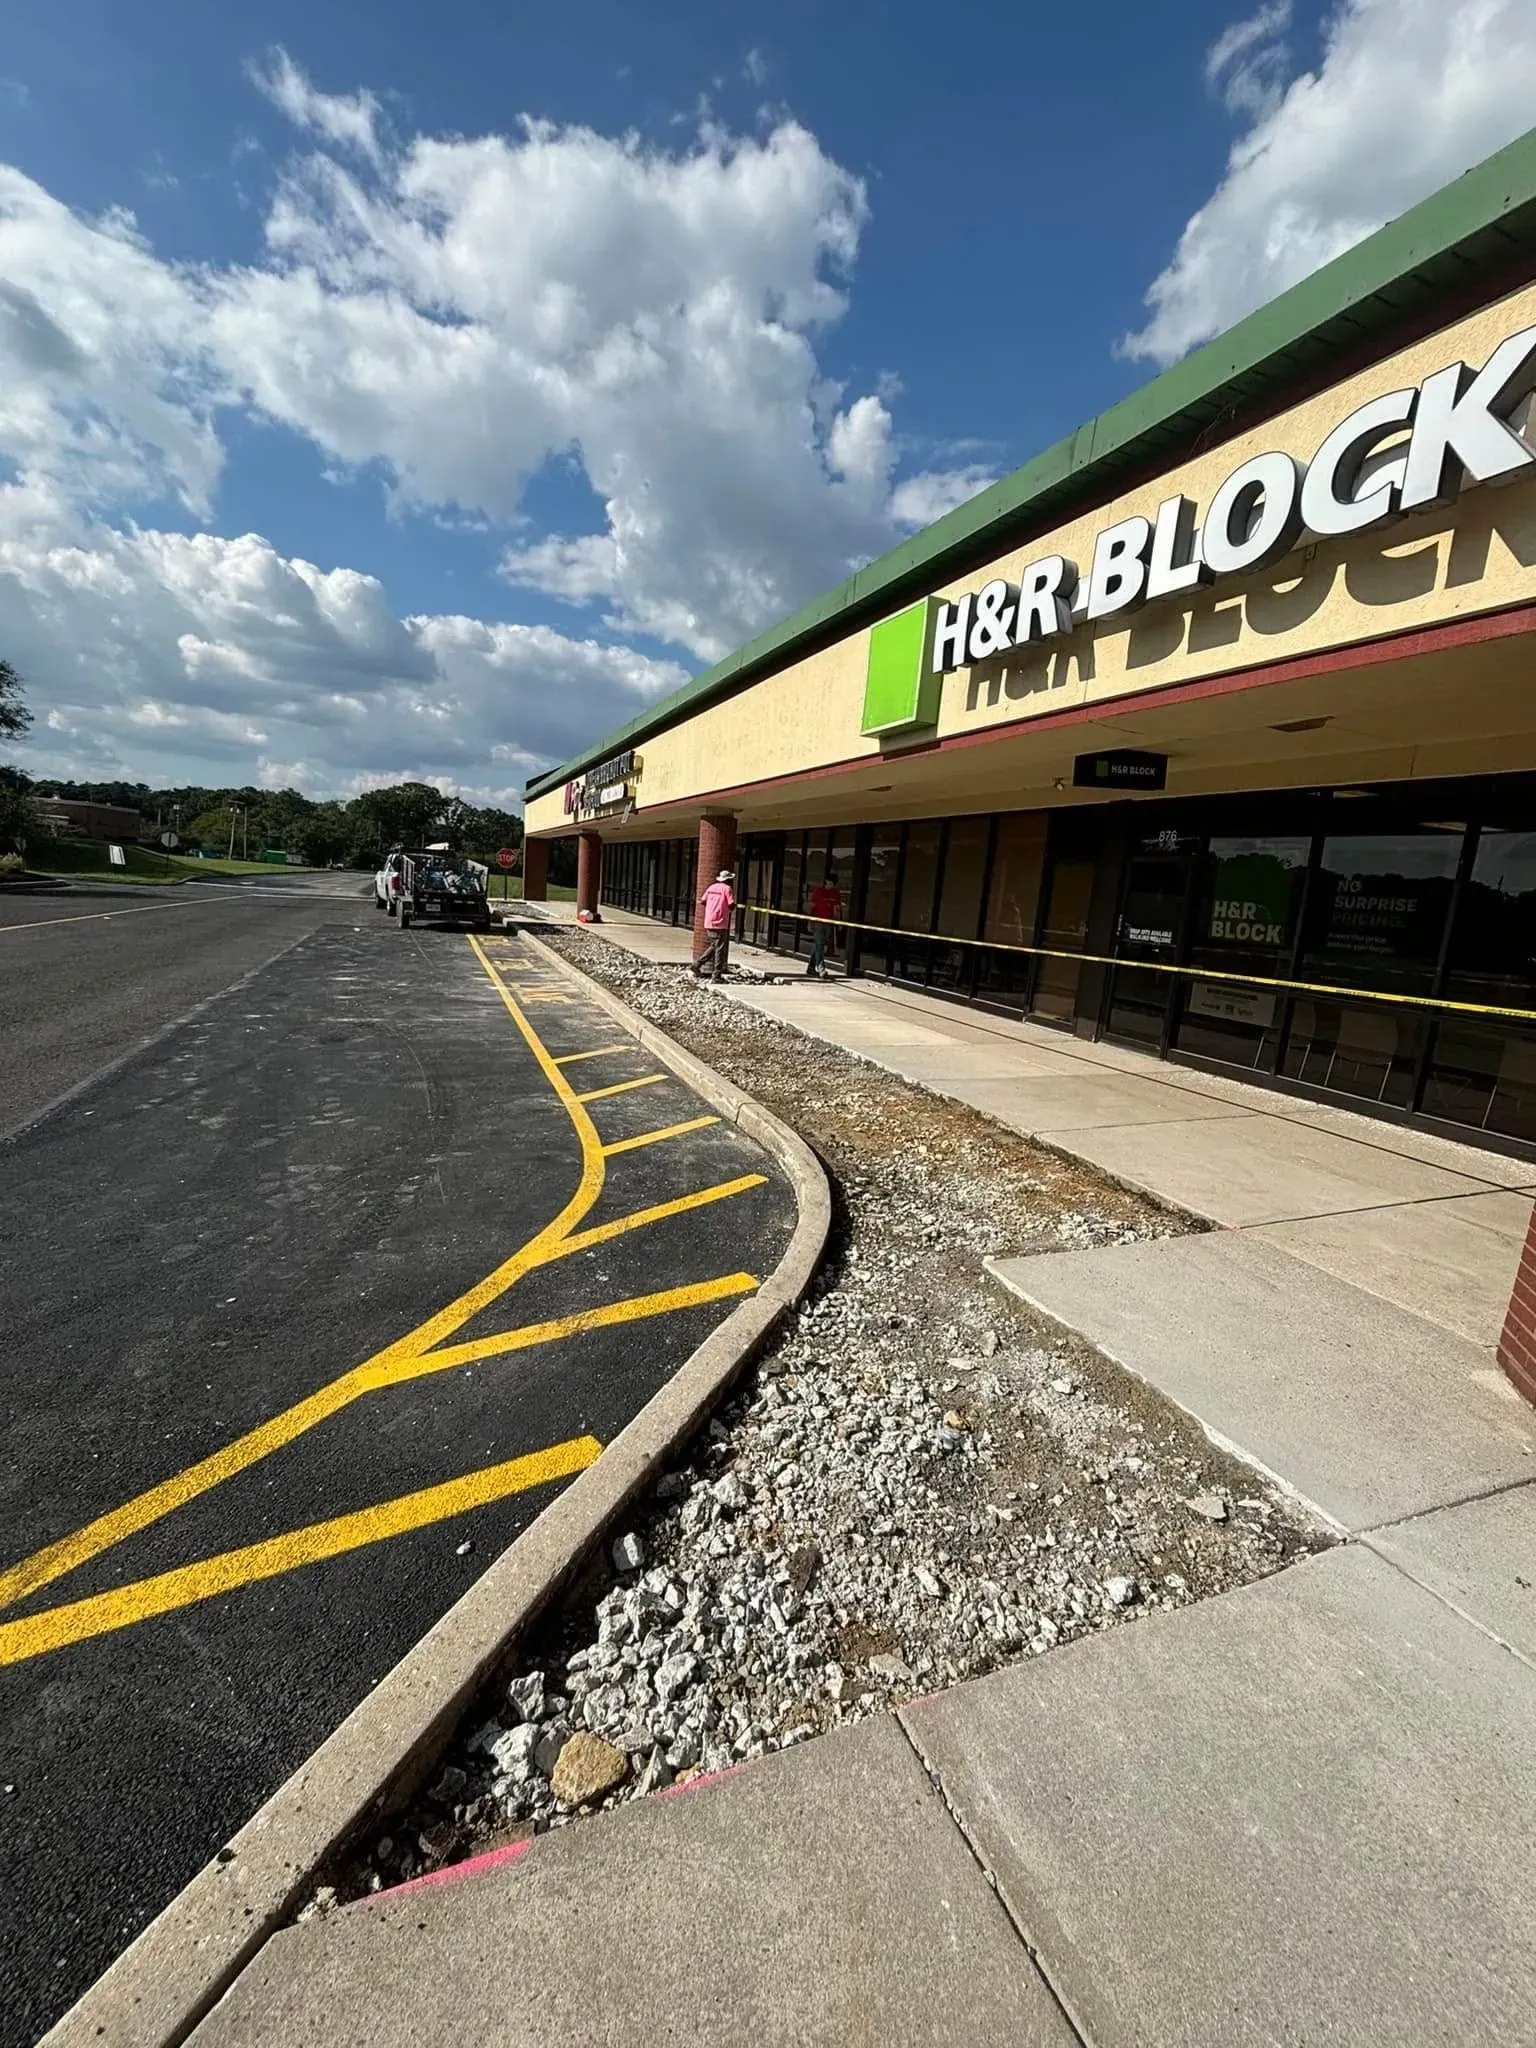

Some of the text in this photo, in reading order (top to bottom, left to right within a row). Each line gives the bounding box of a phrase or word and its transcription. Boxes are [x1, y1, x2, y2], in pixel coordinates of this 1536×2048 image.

[932, 324, 1536, 673] H&R BLOCK
[1111, 764, 1156, 776] H&R BLOCK
[1158, 829, 1177, 842] 876
[499, 854, 514, 863] STOP
[1336, 879, 1362, 893] NO
[1212, 900, 1257, 921] H&R
[1334, 895, 1418, 912] SURPRISE
[1211, 920, 1282, 944] BLOCK
